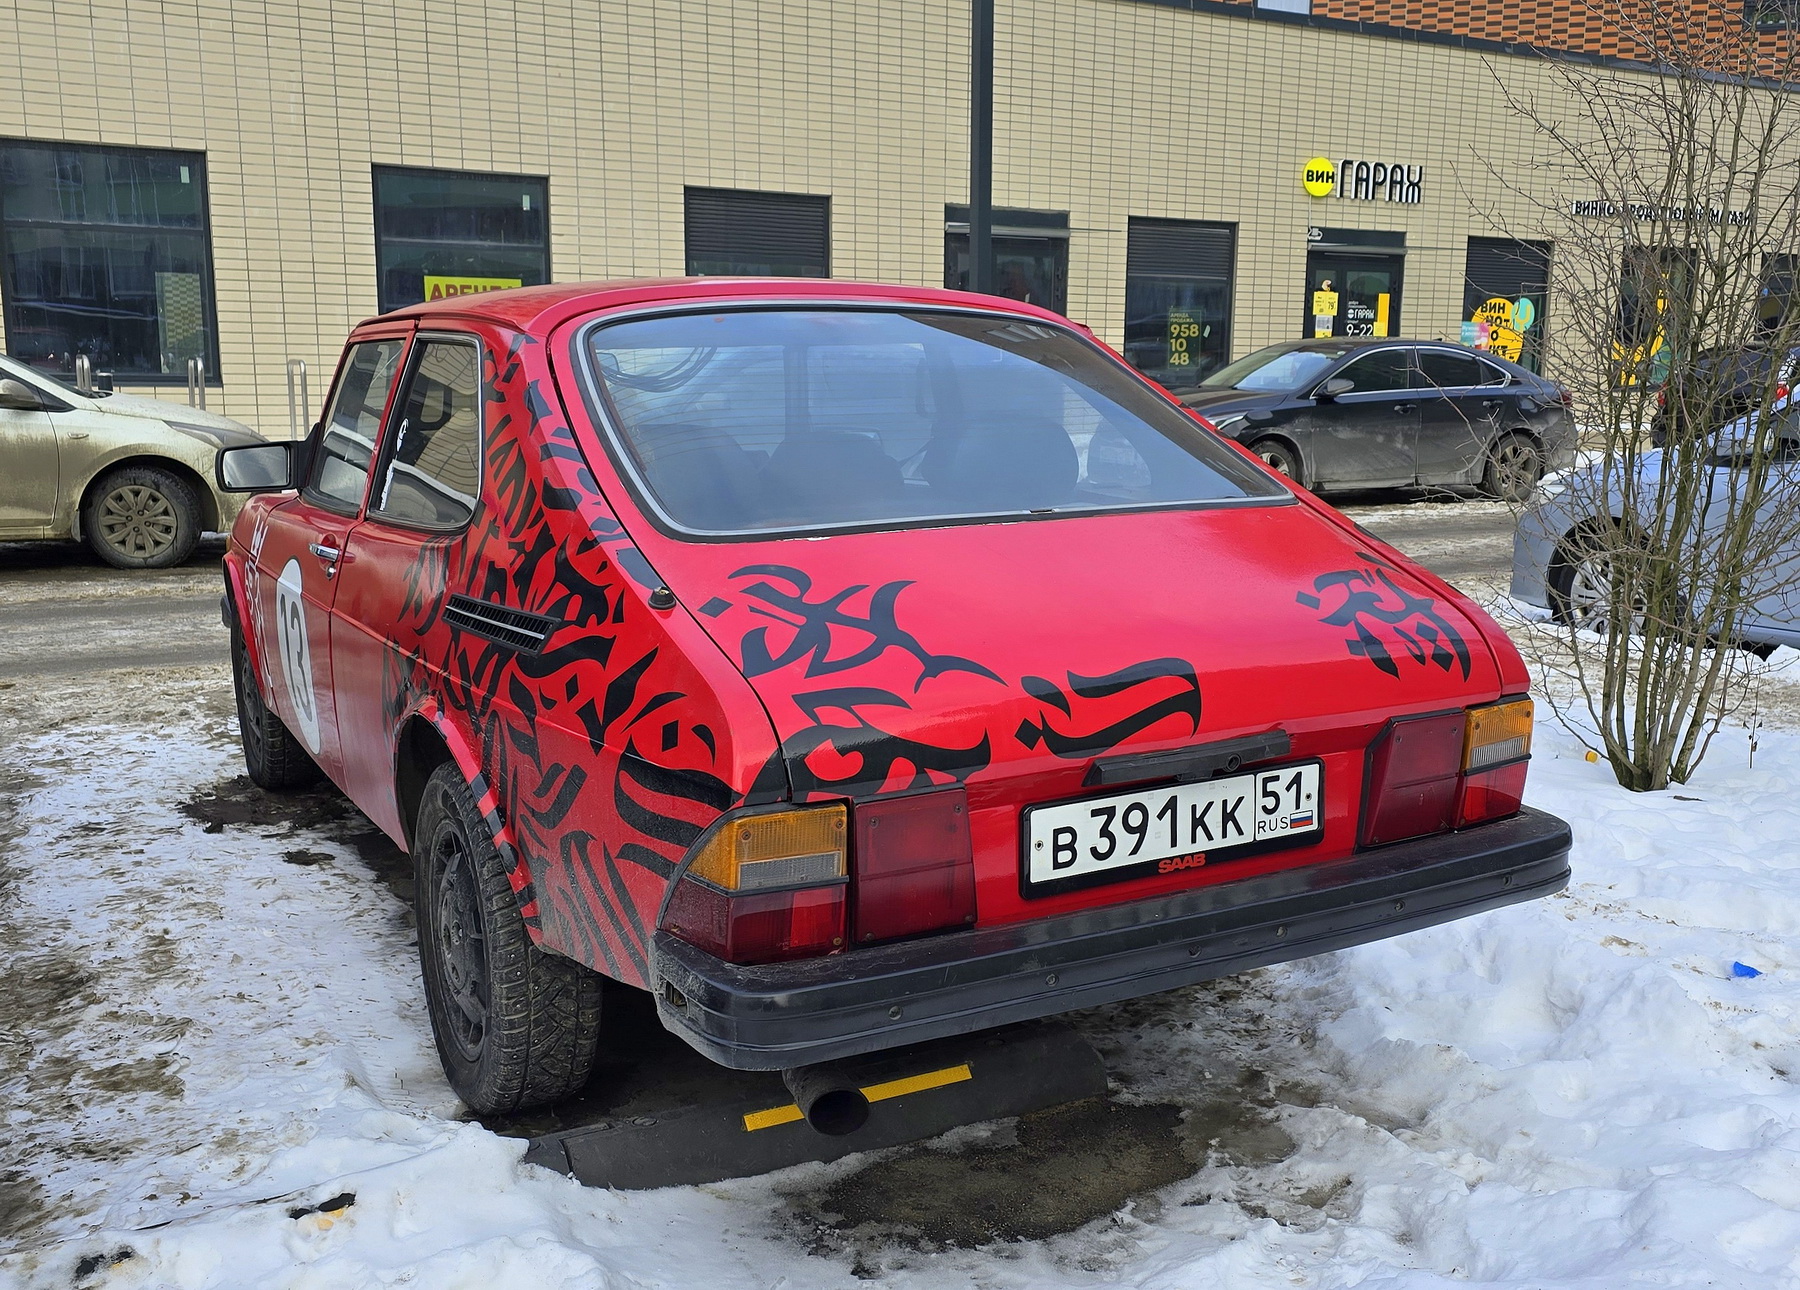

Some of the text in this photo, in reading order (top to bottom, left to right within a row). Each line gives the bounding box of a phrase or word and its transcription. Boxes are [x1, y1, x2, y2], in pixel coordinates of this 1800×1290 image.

[1306, 159, 1423, 204] ВИН ГАРАЖ
[1480, 302, 1506, 314] ВИН
[1170, 324, 1199, 337] 958
[1346, 324, 1373, 337] 9-22
[1170, 338, 1187, 352] 10
[1169, 352, 1189, 365] 48
[281, 593, 313, 723] 13
[1261, 771, 1303, 816] 51
[1257, 816, 1288, 835] RUS
[1158, 853, 1206, 873] SAAB
